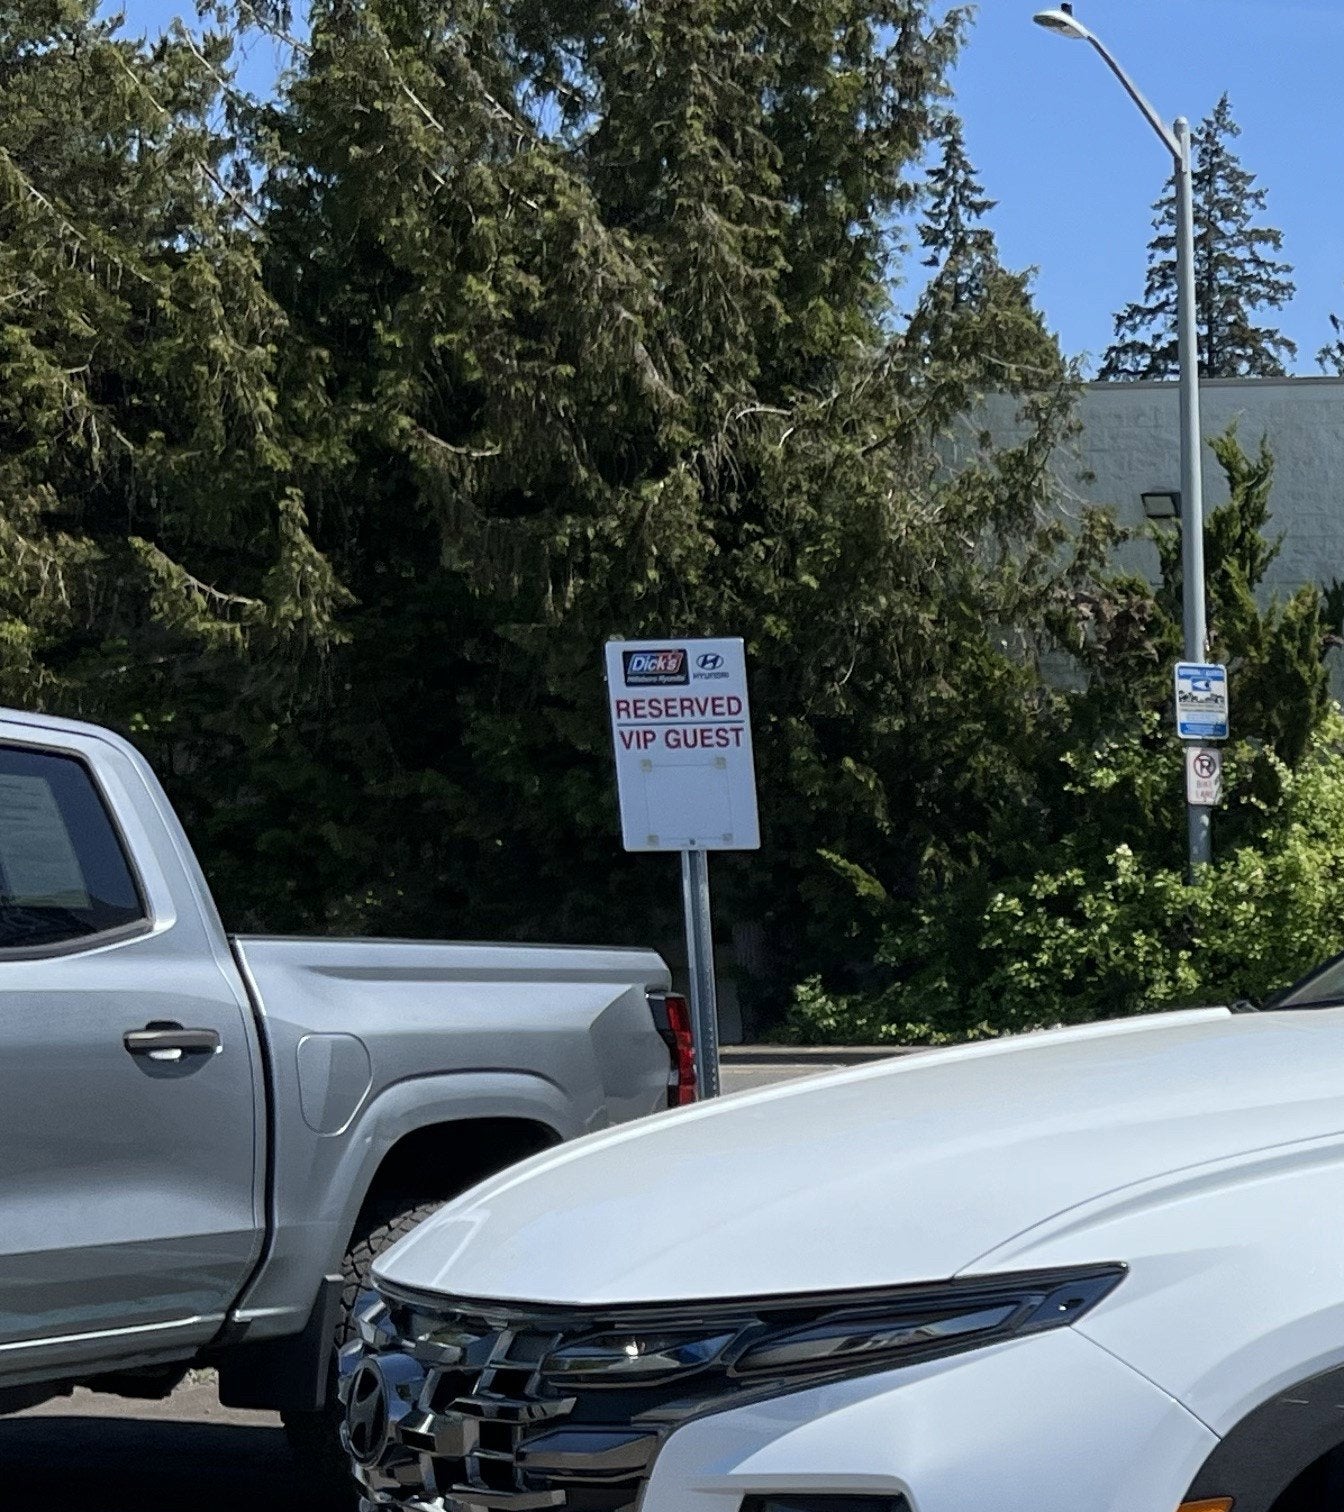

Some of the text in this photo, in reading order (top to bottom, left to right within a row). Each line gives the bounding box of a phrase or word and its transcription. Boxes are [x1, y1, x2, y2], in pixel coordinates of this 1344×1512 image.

[615, 696, 743, 719] RESERVED
[619, 727, 745, 750] VIP GUEST
